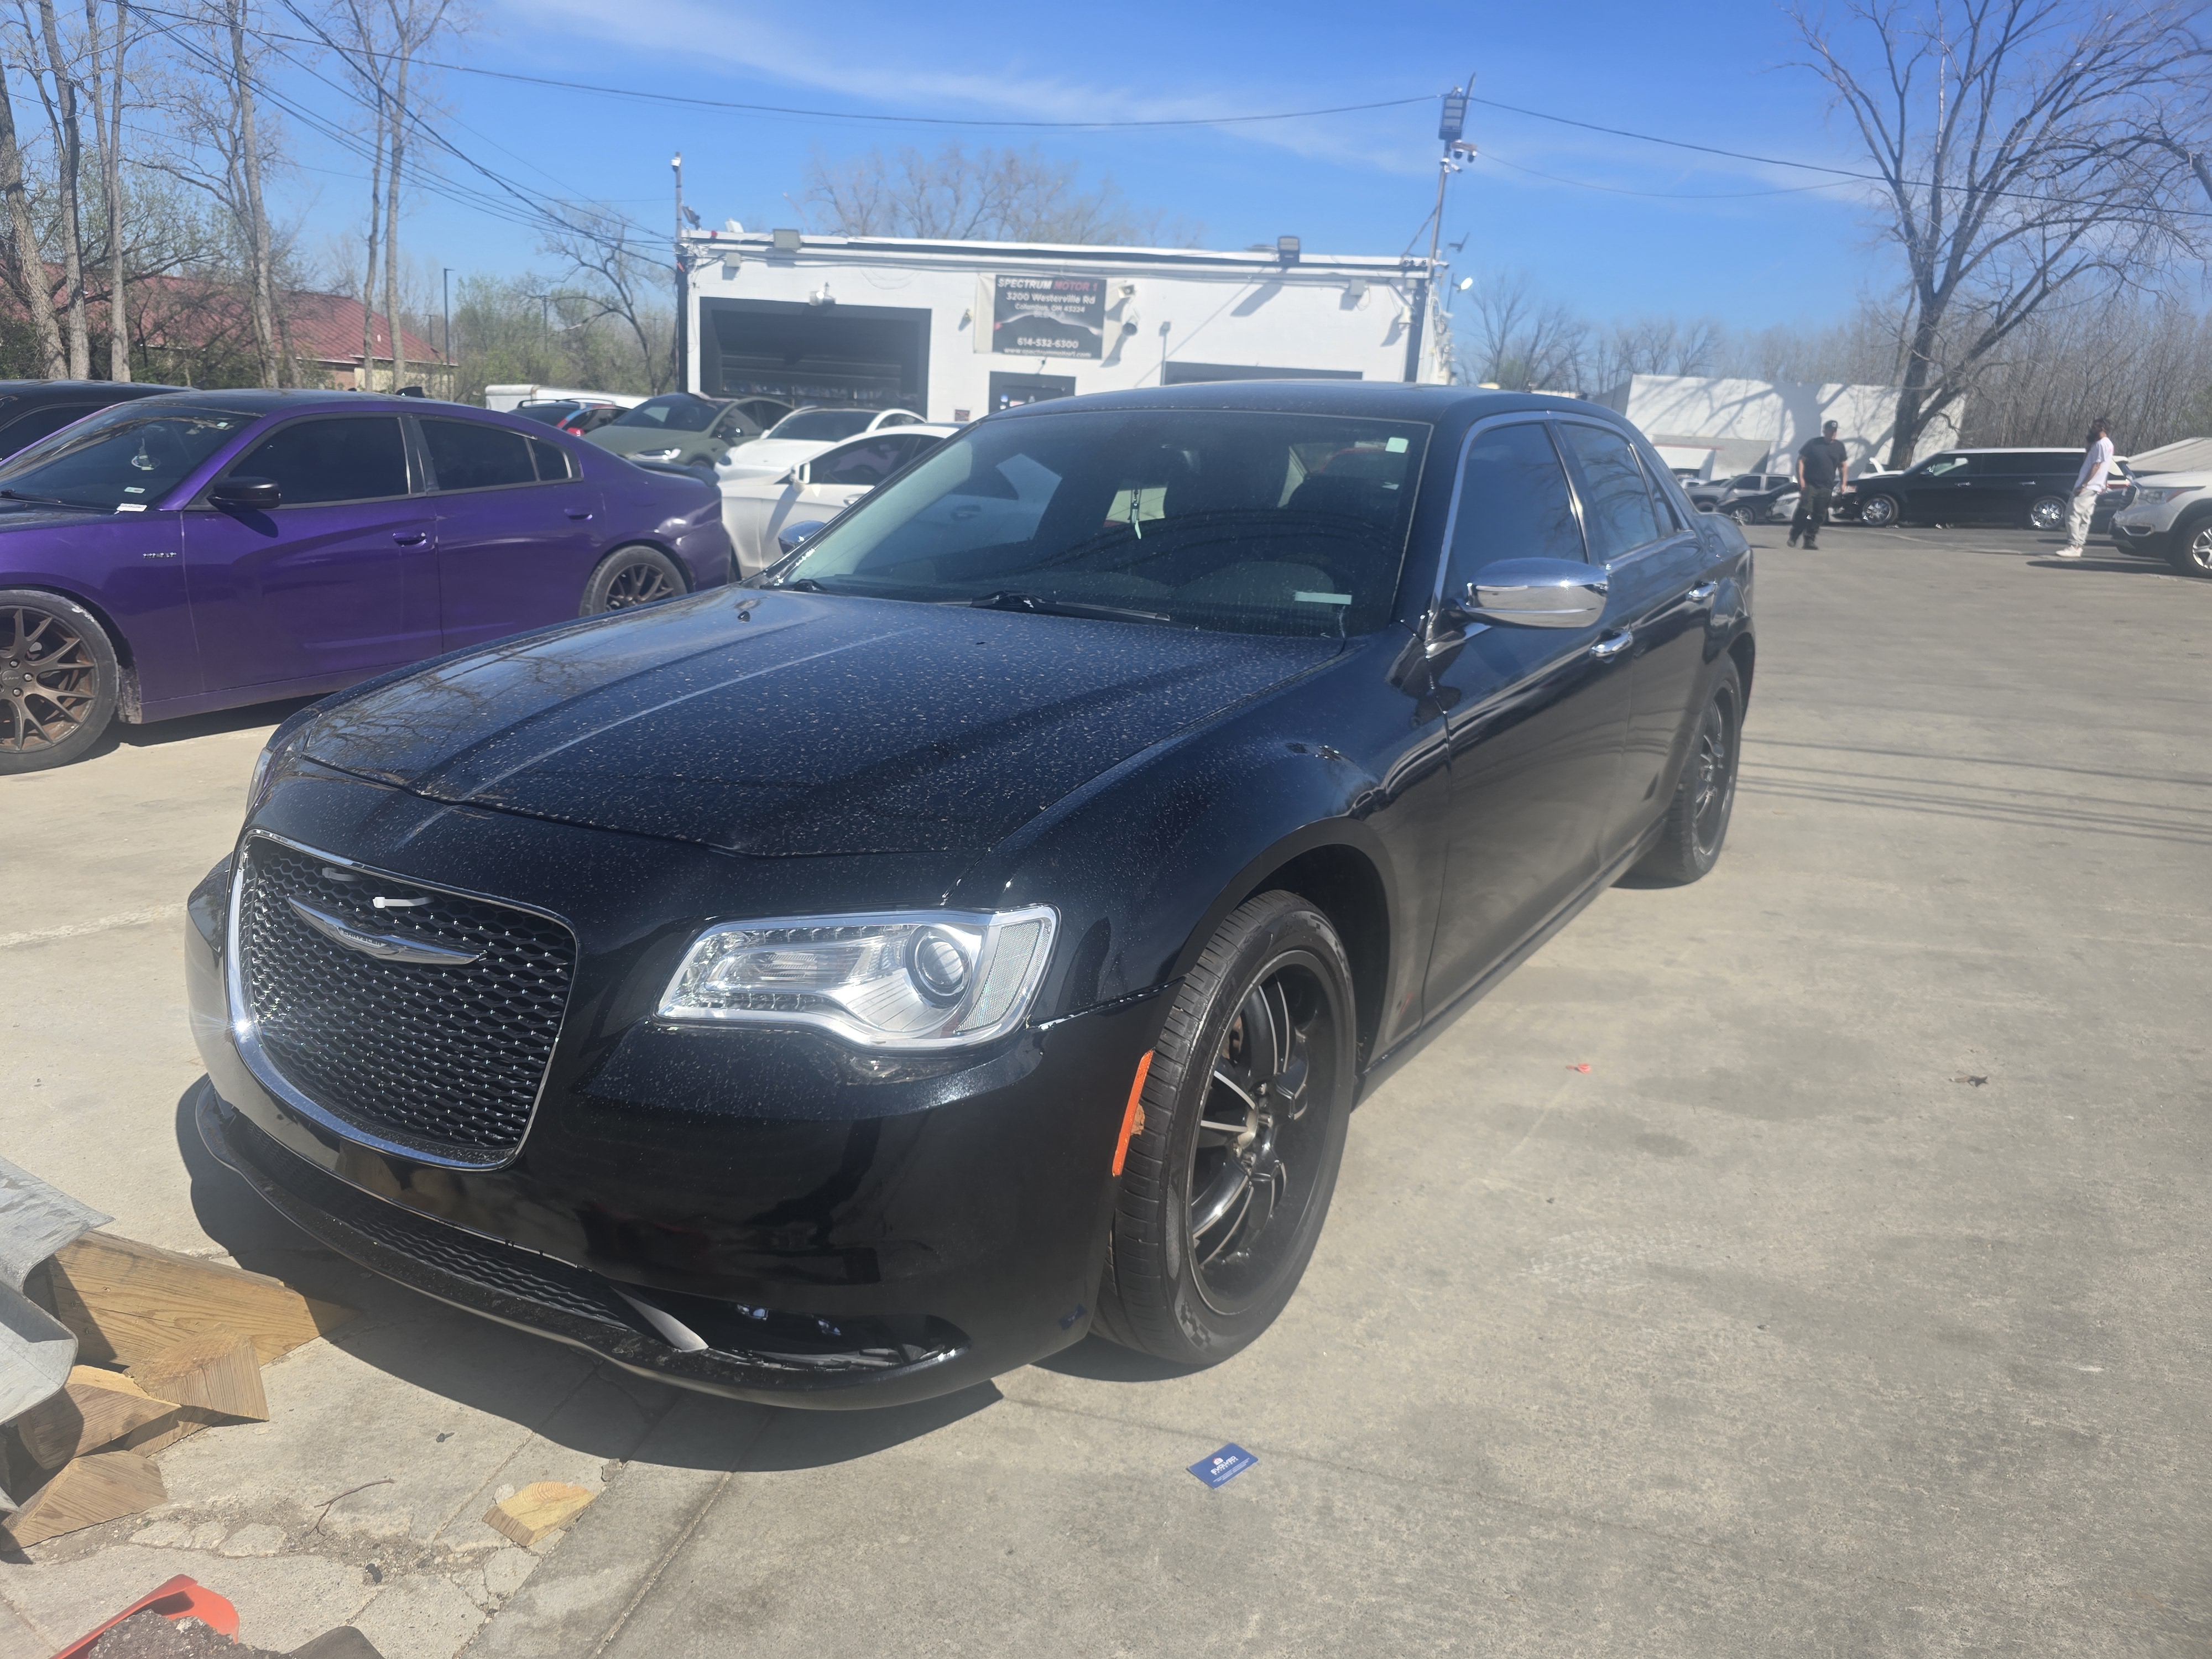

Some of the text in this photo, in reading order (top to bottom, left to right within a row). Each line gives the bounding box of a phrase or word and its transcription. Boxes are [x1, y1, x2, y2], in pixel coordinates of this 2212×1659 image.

[998, 278, 1052, 290] SPECTRUM
[1053, 281, 1090, 291] MOTOR
[1006, 292, 1095, 304] 3200 Westerville Rd
[1015, 303, 1050, 312] Columbus,
[1017, 337, 1079, 348] 614-532-6300
[342, 931, 383, 946] CHRYSLER
